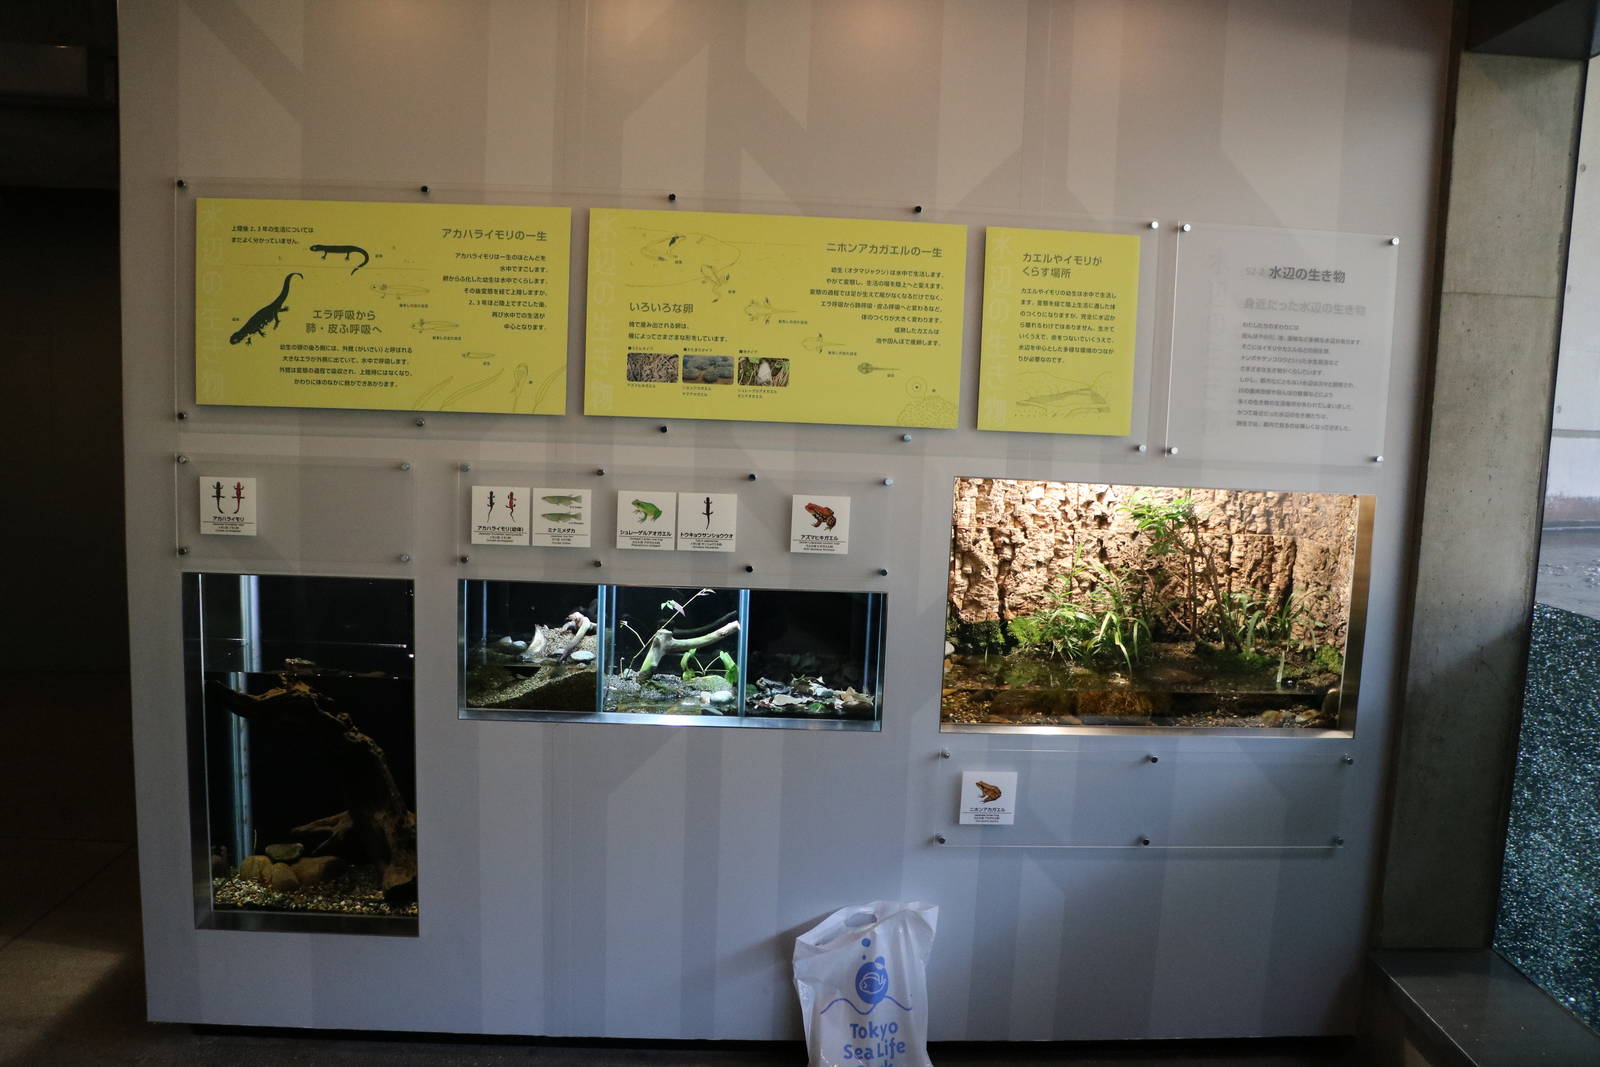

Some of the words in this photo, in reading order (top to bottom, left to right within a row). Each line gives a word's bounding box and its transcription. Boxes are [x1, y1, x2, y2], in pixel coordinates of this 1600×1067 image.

[441, 228, 547, 241] アカハライモリの一生
[455, 252, 546, 261] アカハライモリは一生のほとんどを
[826, 242, 943, 258] ニホンアカガエルの一生
[1022, 253, 1103, 266] カエルやイモリが
[1022, 266, 1071, 279] くらす場所
[1269, 265, 1346, 284] 水辺の生き物
[629, 302, 694, 314] いろいろな卵
[312, 309, 376, 321] エラ呼吸から
[305, 322, 382, 335] 肺・皮ふ呼吸へ
[504, 323, 546, 331] 中心となります。
[619, 529, 672, 537] シュレーゲルアオガエル
[680, 531, 734, 539] トウキョウサンショウウオ
[849, 1021, 899, 1041] Tokyo
[843, 1044, 874, 1061] Sea
[877, 1037, 907, 1060] Life
